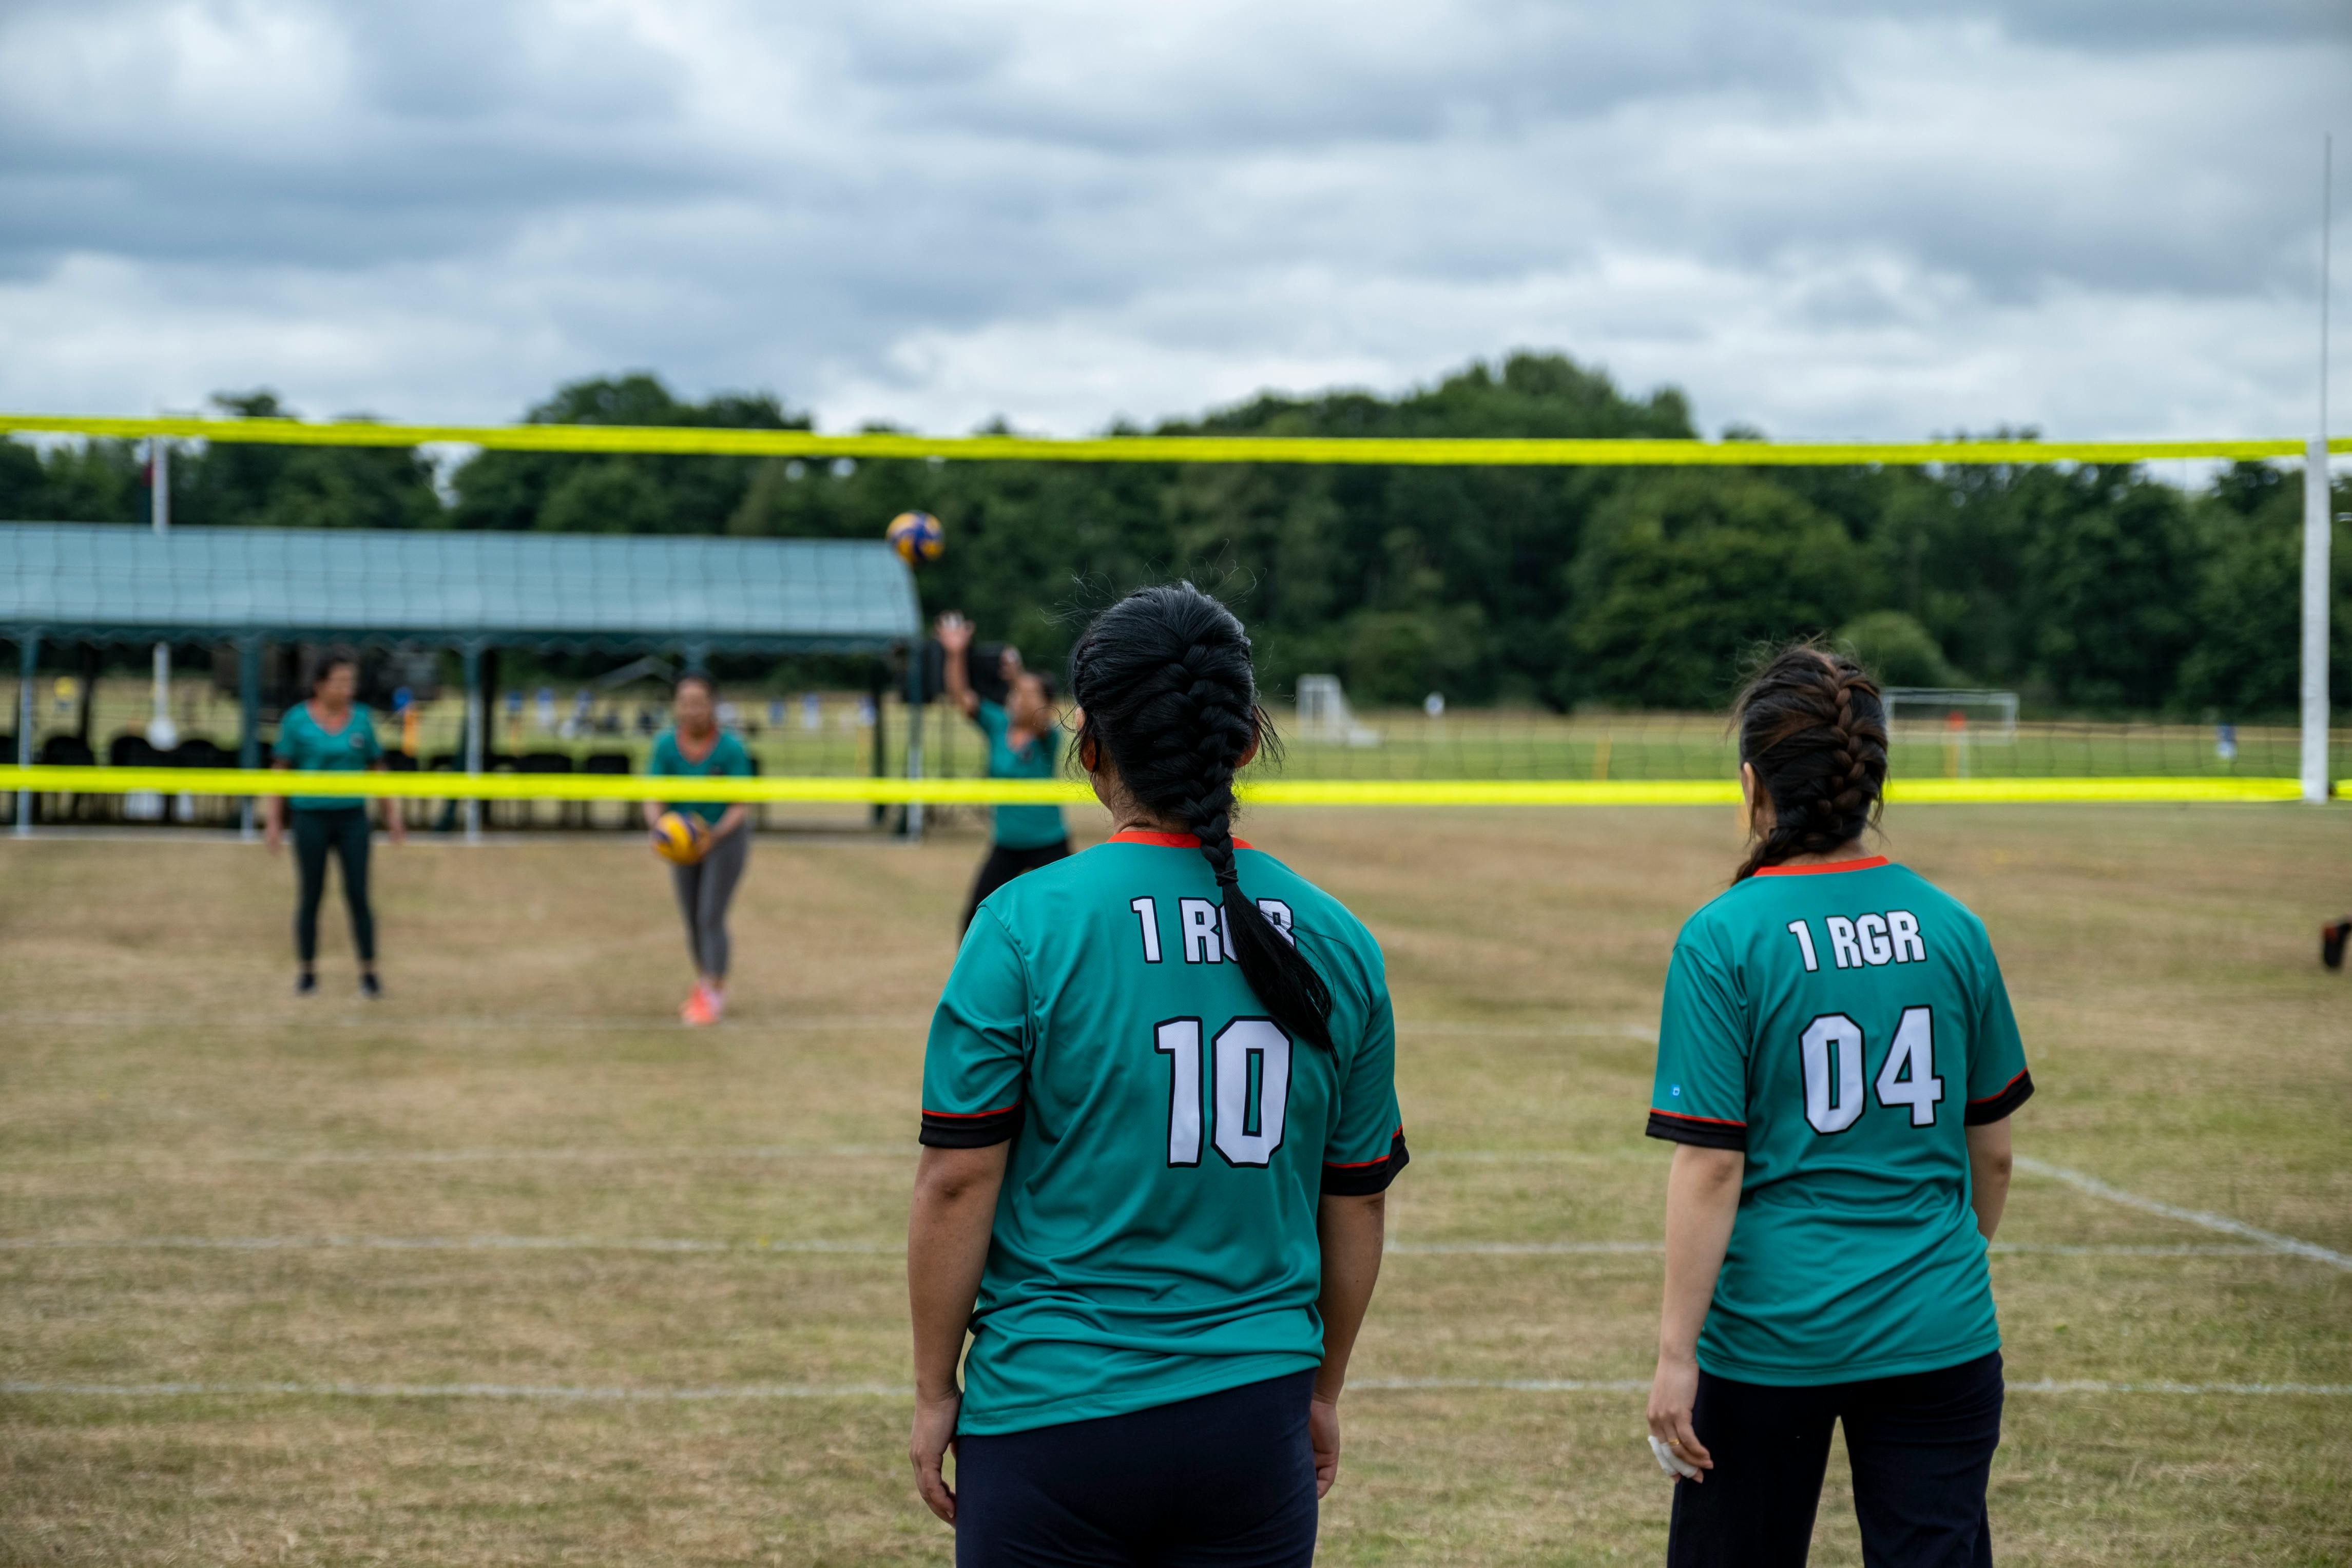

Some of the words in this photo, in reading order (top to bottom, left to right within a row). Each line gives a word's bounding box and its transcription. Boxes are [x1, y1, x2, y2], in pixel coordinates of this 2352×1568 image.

[1130, 896, 1163, 963] 1
[1179, 897, 1297, 964] RR
[1787, 919, 1818, 972] 1
[1825, 910, 1927, 969] RGR
[1154, 1016, 1294, 1169] 10
[1799, 1004, 1944, 1136] 04
